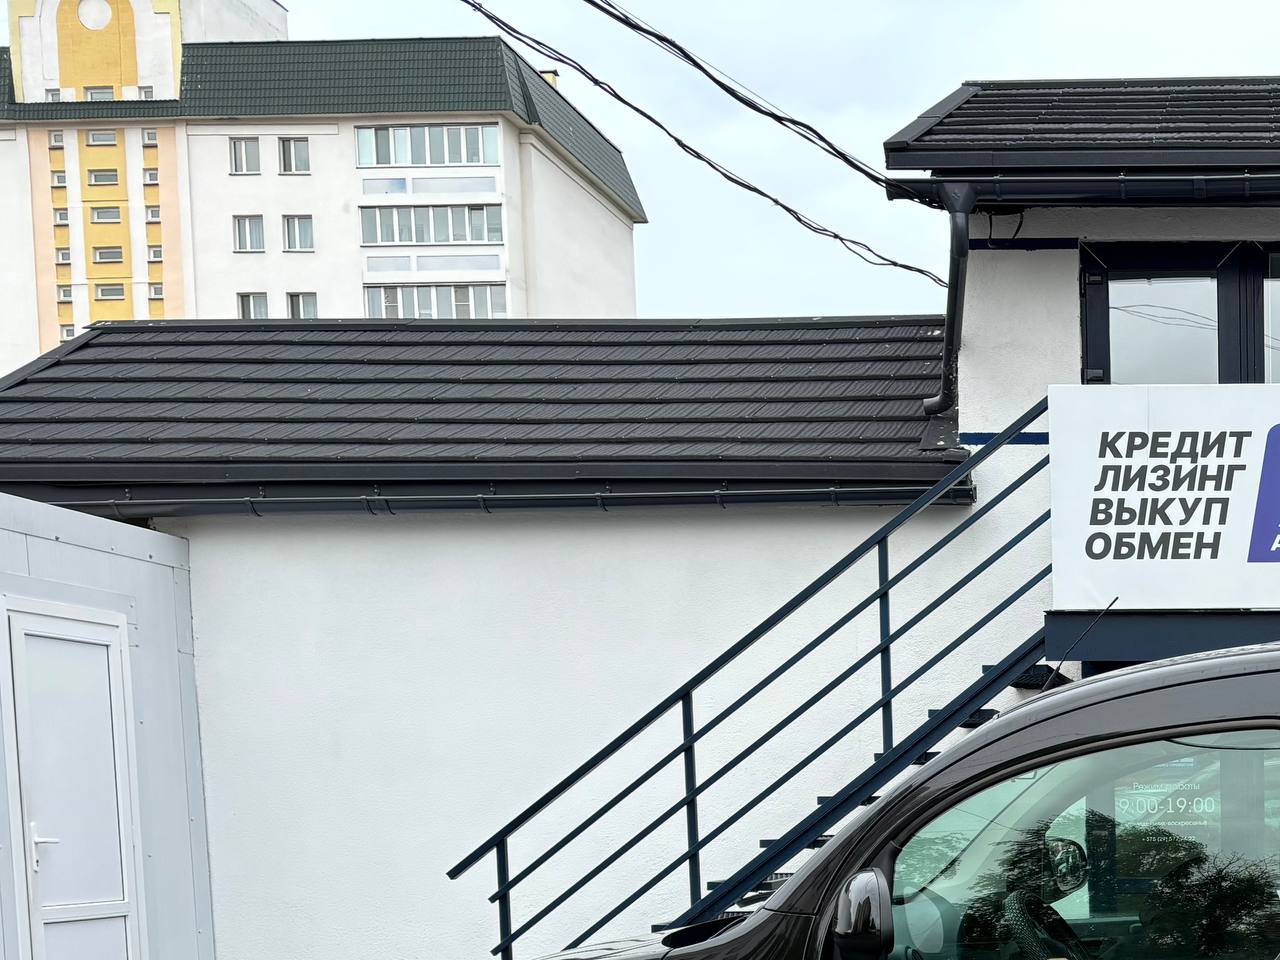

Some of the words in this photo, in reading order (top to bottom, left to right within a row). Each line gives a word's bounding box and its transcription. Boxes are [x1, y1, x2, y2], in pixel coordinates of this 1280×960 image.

[1098, 431, 1253, 464] КРЕДИТ
[1093, 464, 1247, 492] ЛИЗИНГ
[1089, 497, 1230, 526] ВЫКУП
[1085, 531, 1222, 560] ОБМЕН
[1119, 797, 1215, 814] 9:00-19:00
